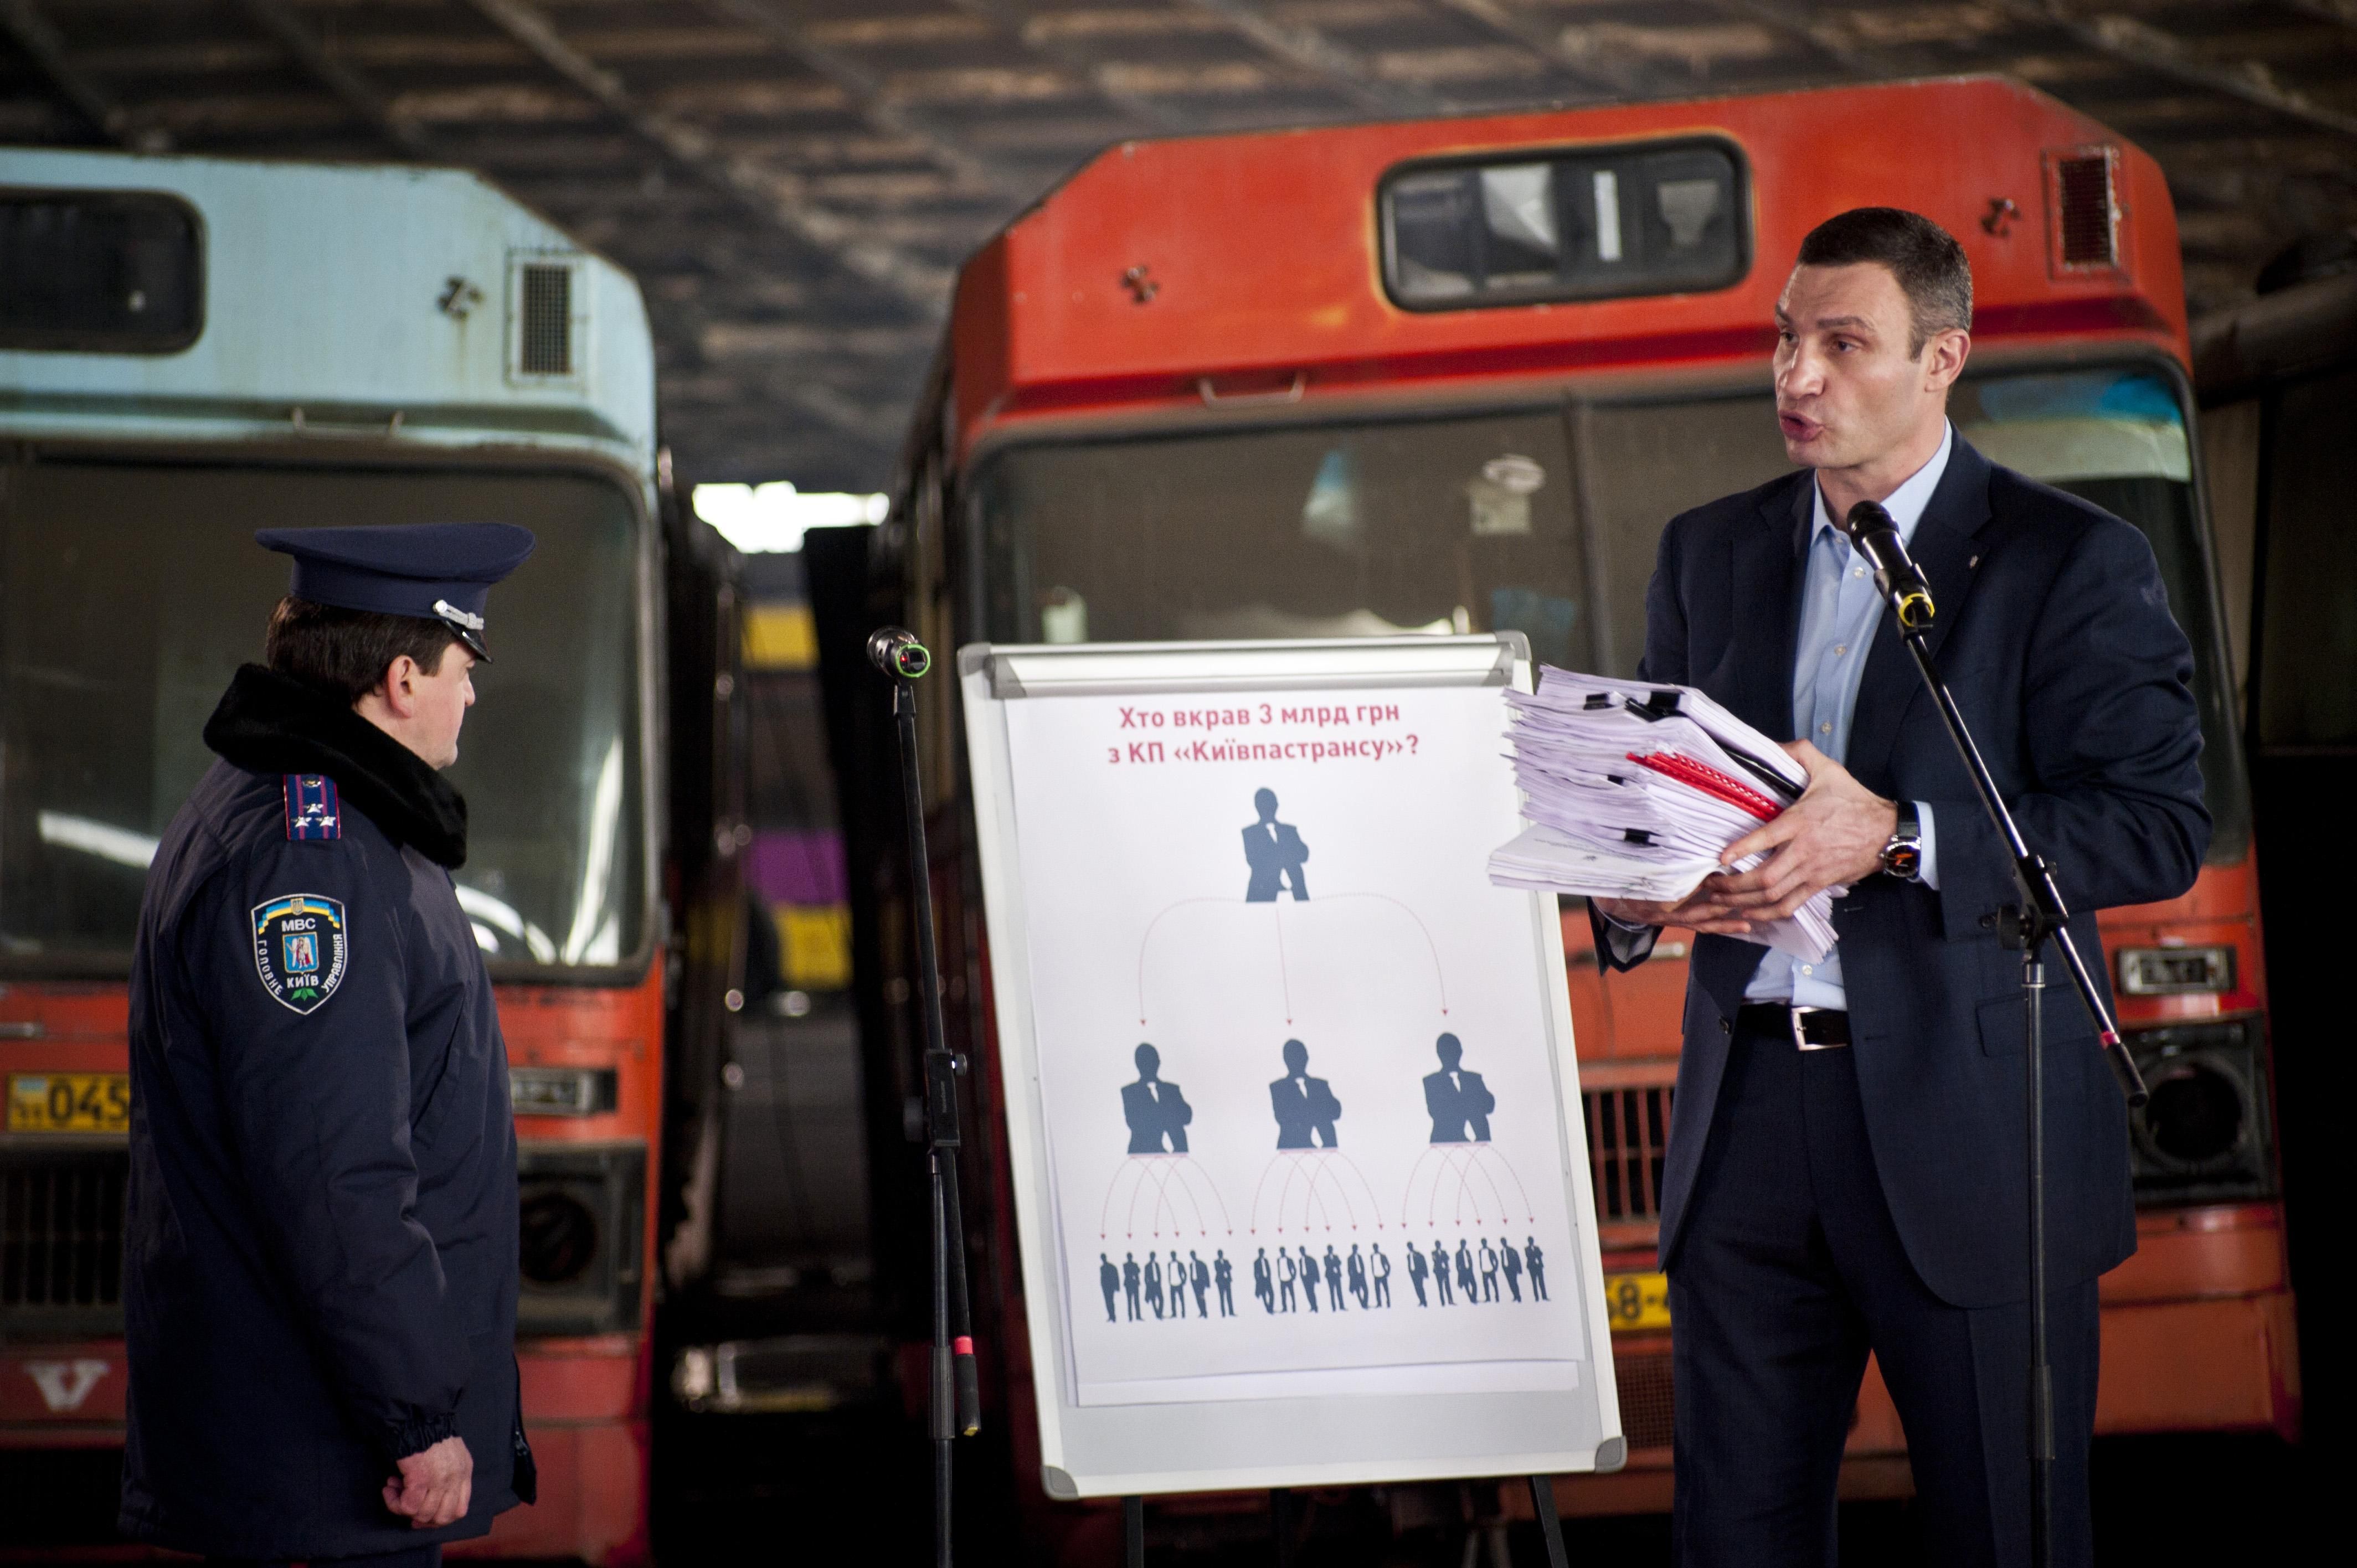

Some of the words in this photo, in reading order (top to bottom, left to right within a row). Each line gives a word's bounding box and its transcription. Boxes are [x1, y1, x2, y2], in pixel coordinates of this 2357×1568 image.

[1119, 708, 1164, 728] Хто
[1174, 709, 1250, 730] вкрав
[1259, 703, 1273, 724] 3
[1281, 706, 1350, 728] млрд
[1356, 704, 1400, 726] грн
[1108, 747, 1120, 764] з
[1128, 742, 1164, 763] КП
[281, 918, 316, 932] МВС
[258, 940, 284, 996] ГОЛОВНЕ
[321, 933, 343, 993] УПРАВЛІННЯ
[286, 973, 319, 989] КИЇВ
